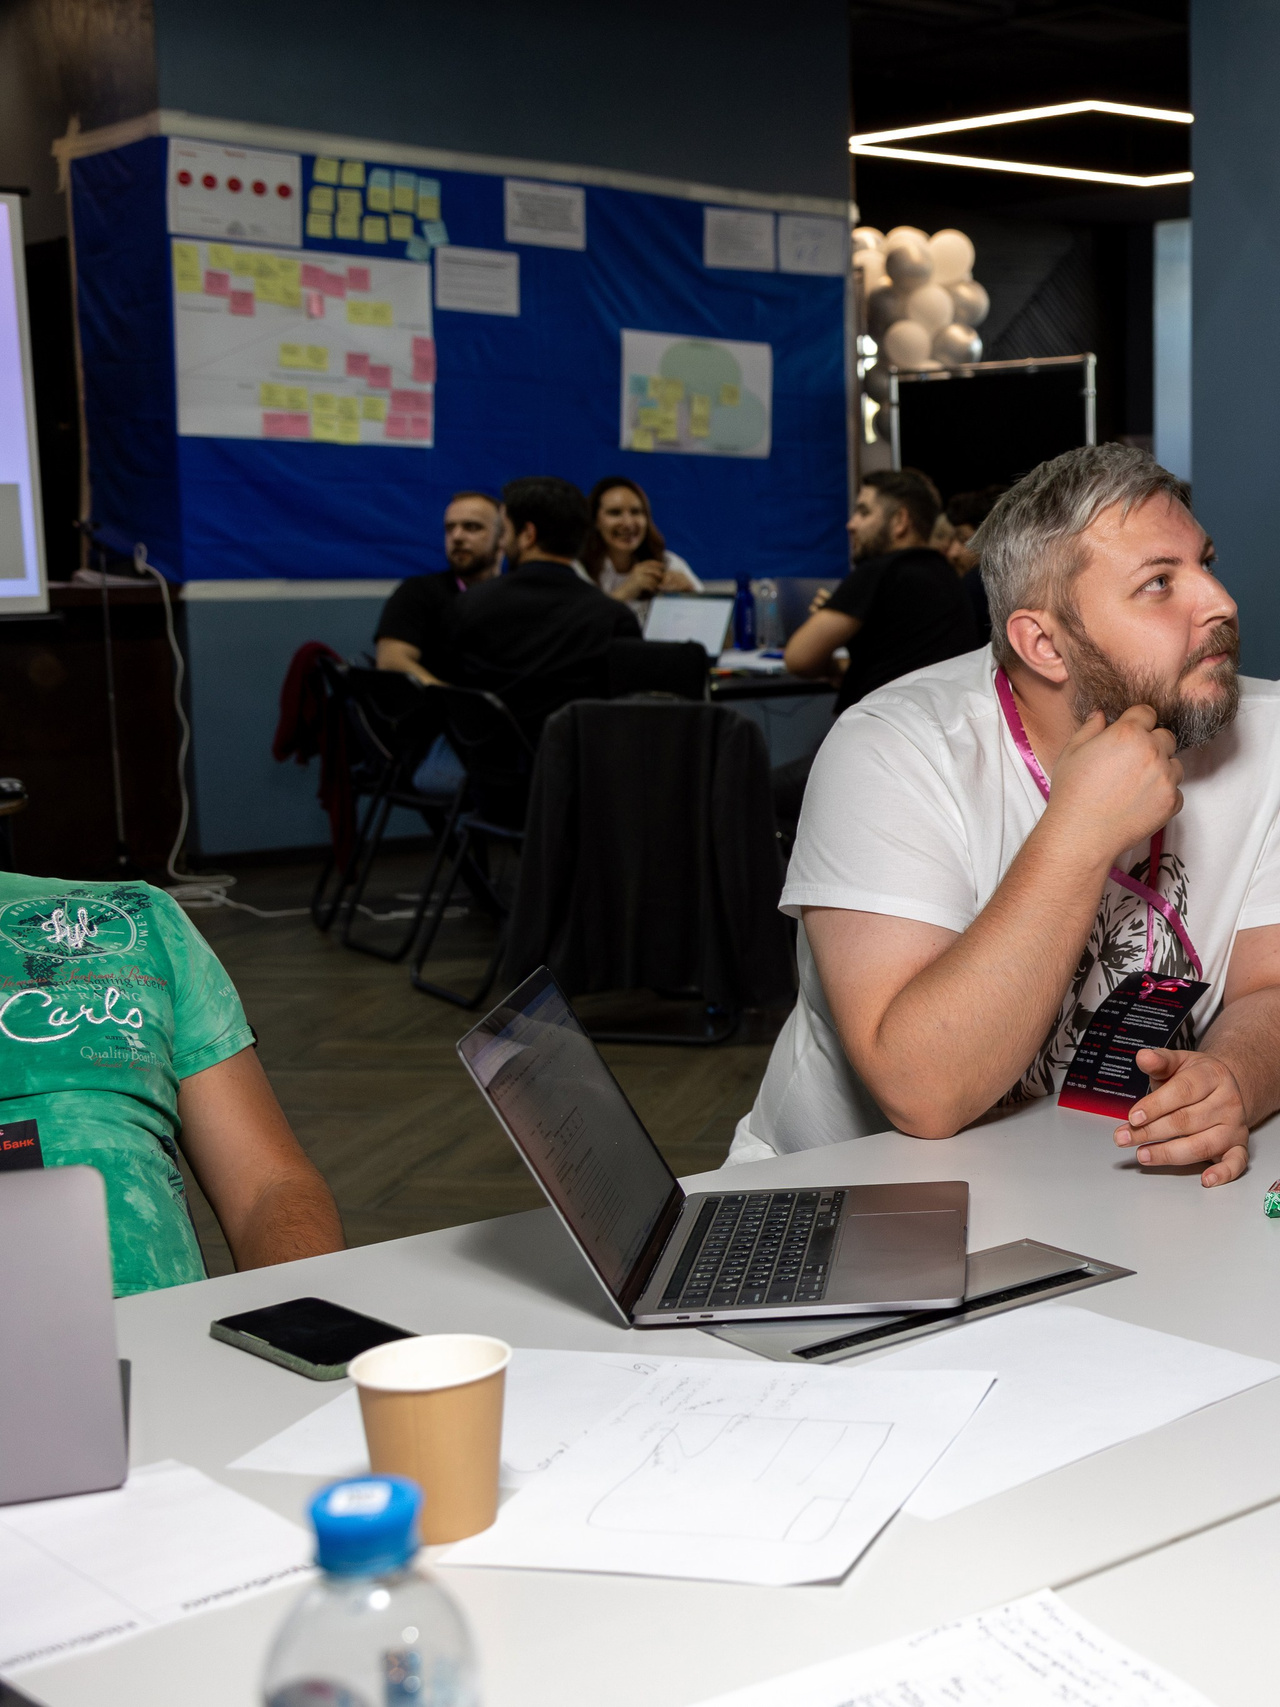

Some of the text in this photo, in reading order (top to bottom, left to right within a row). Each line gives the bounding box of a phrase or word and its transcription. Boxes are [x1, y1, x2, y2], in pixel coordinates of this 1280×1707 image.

[10, 900, 47, 916] NORTH
[80, 1046, 128, 1062] Quality
[3, 1138, 35, 1150] Банк
